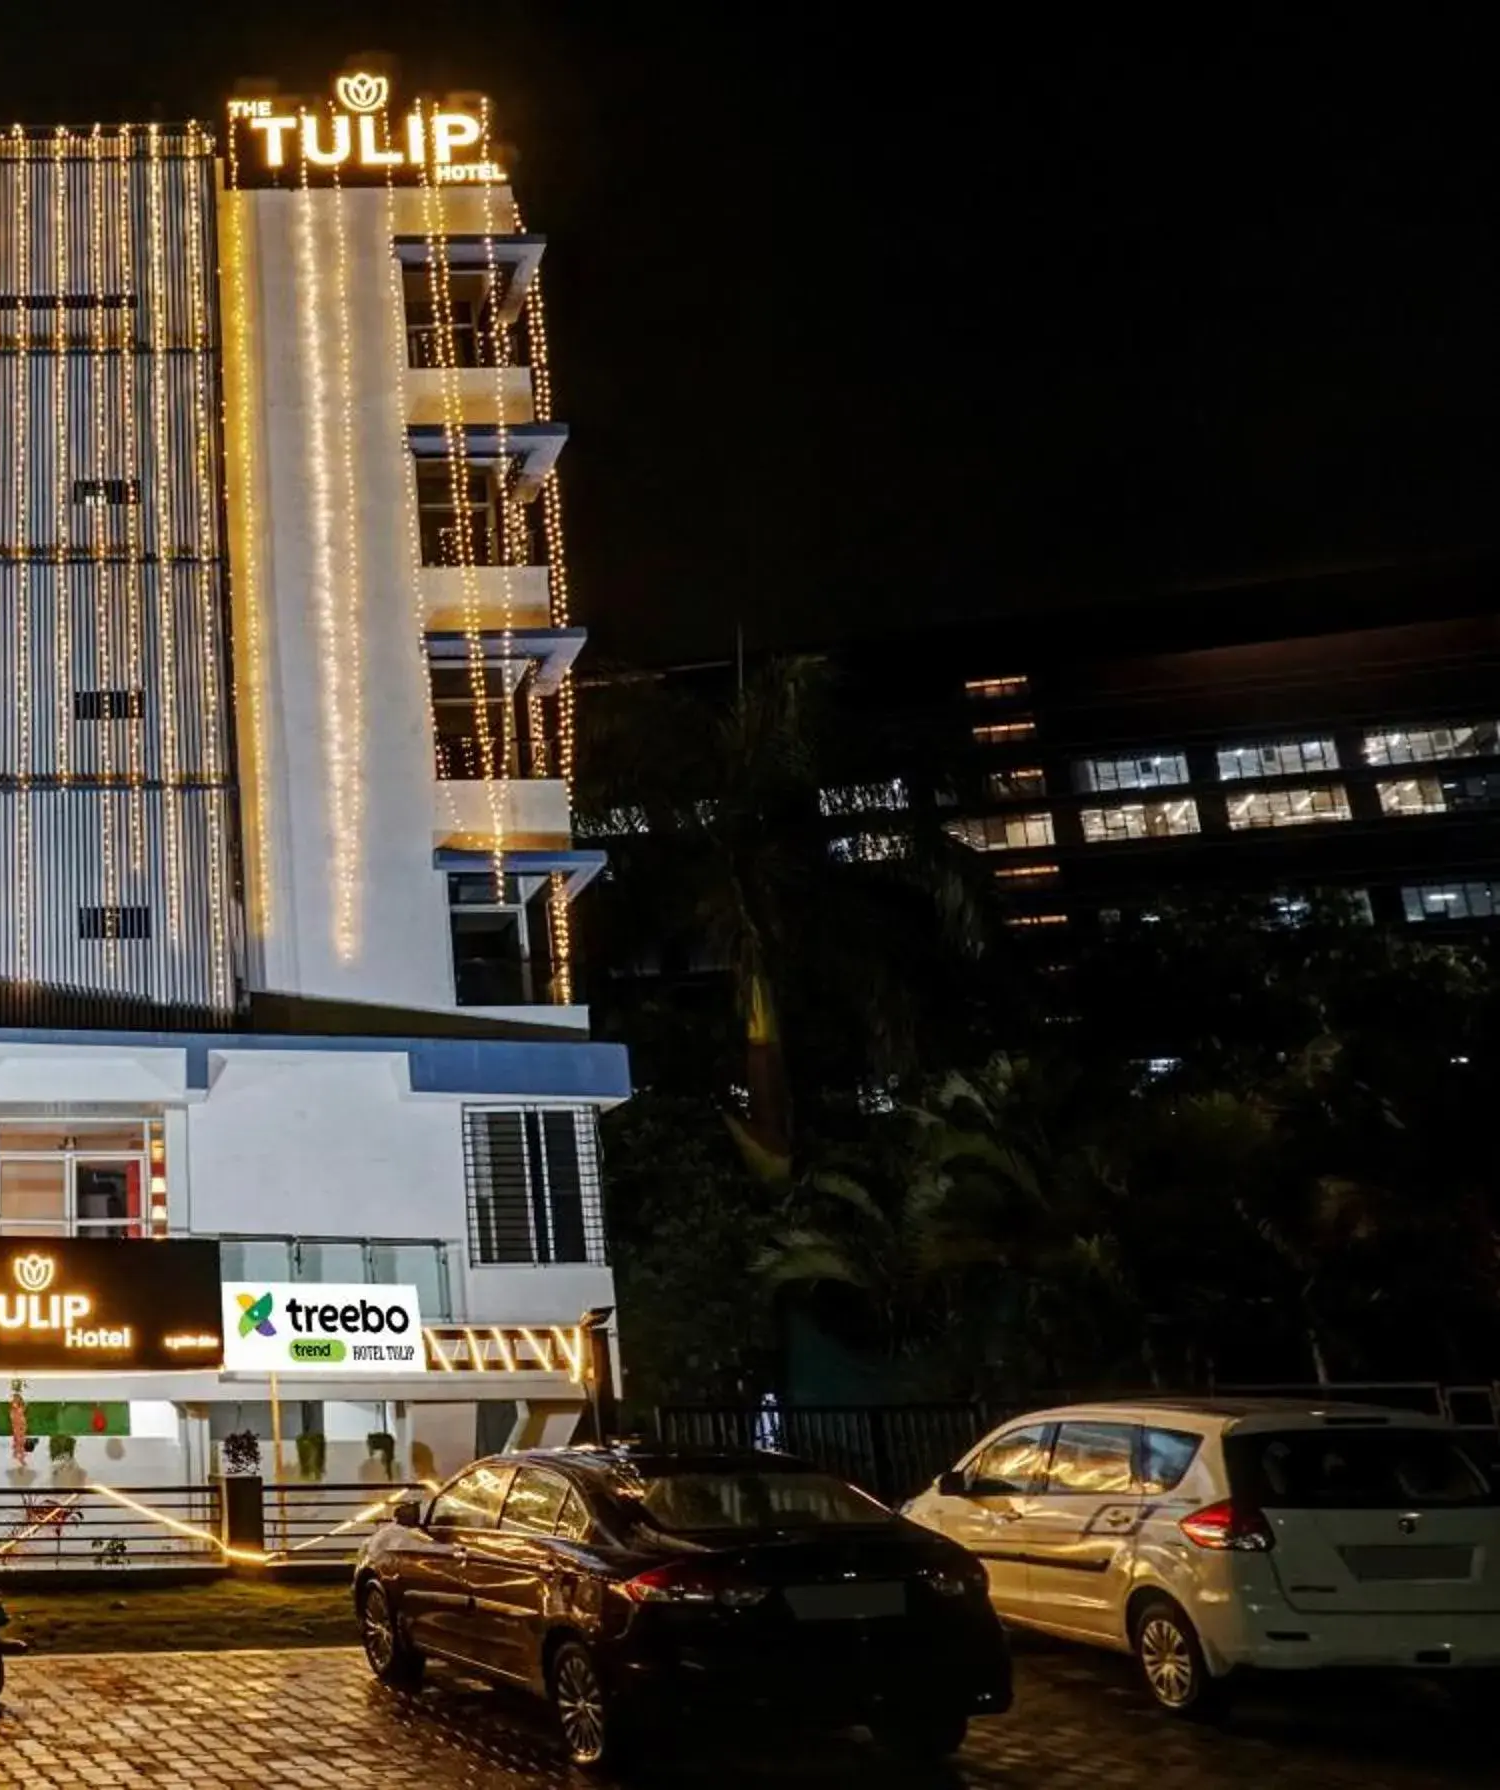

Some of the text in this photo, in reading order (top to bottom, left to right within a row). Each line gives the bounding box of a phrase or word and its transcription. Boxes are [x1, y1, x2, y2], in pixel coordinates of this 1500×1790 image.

[228, 101, 272, 117] THE
[250, 113, 481, 167] TULIP
[436, 164, 507, 182] HOTEL
[285, 1298, 409, 1334] treebo
[65, 1327, 131, 1348] Hotel
[293, 1343, 331, 1357] trend
[353, 1345, 385, 1360] HOTEL
